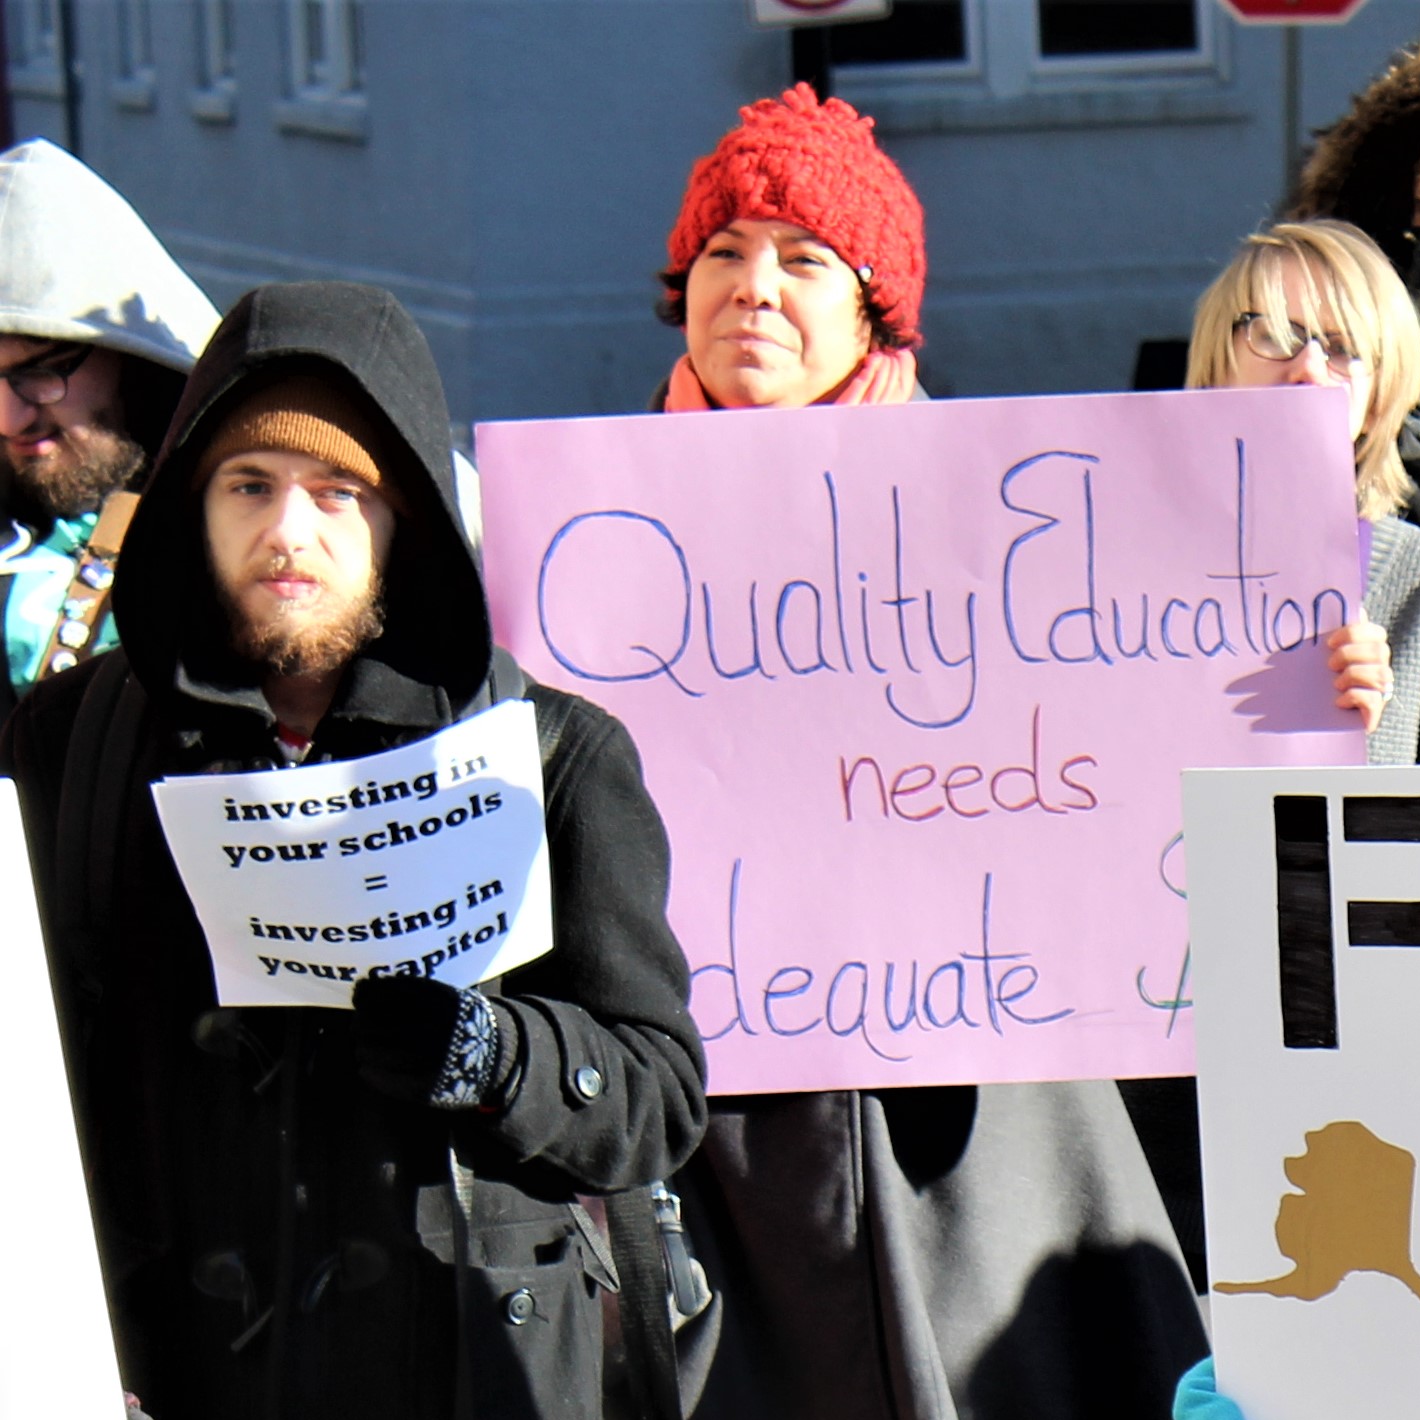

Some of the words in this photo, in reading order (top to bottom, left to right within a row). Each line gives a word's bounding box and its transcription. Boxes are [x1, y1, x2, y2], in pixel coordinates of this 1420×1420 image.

[538, 471, 976, 728] Quality
[1001, 437, 1346, 666] Education
[225, 769, 439, 821] investing
[450, 753, 489, 782] in
[839, 704, 1100, 821] needs
[223, 838, 328, 868] your
[340, 790, 503, 857] schools
[250, 899, 457, 943] investing
[466, 876, 504, 909] in
[364, 873, 388, 892] =
[258, 954, 358, 983] your
[691, 857, 1075, 1062] dequate
